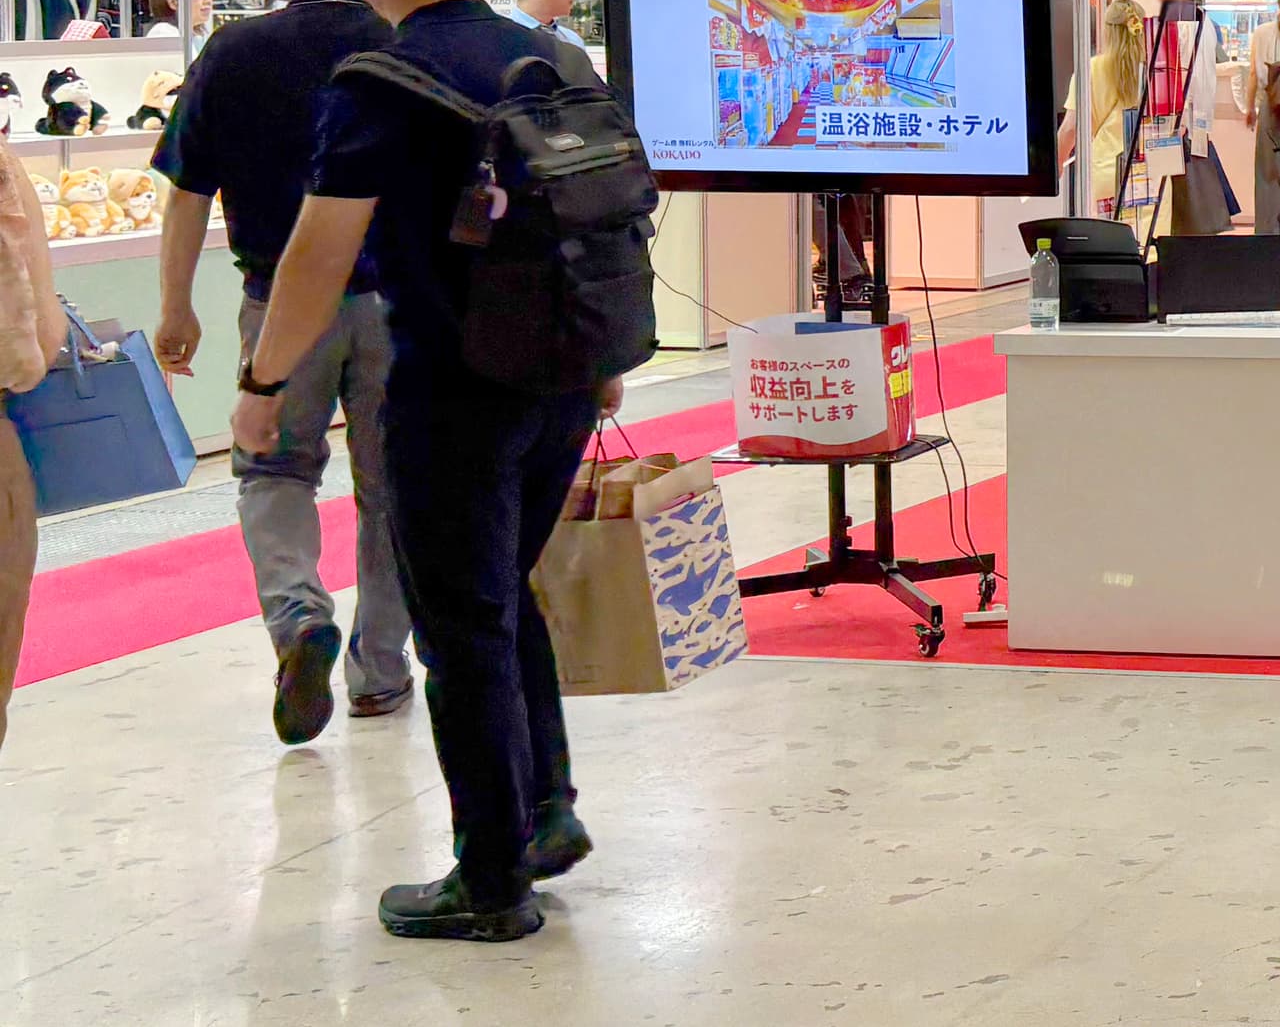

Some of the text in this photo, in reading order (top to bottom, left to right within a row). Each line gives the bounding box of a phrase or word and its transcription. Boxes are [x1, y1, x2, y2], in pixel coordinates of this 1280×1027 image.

[821, 111, 1009, 138] 温浴施設・ホテル
[653, 150, 701, 160] KOKADO
[751, 358, 850, 372] お客様のスペースの
[750, 374, 856, 401] 収益向上を
[749, 403, 858, 423] サポートします
